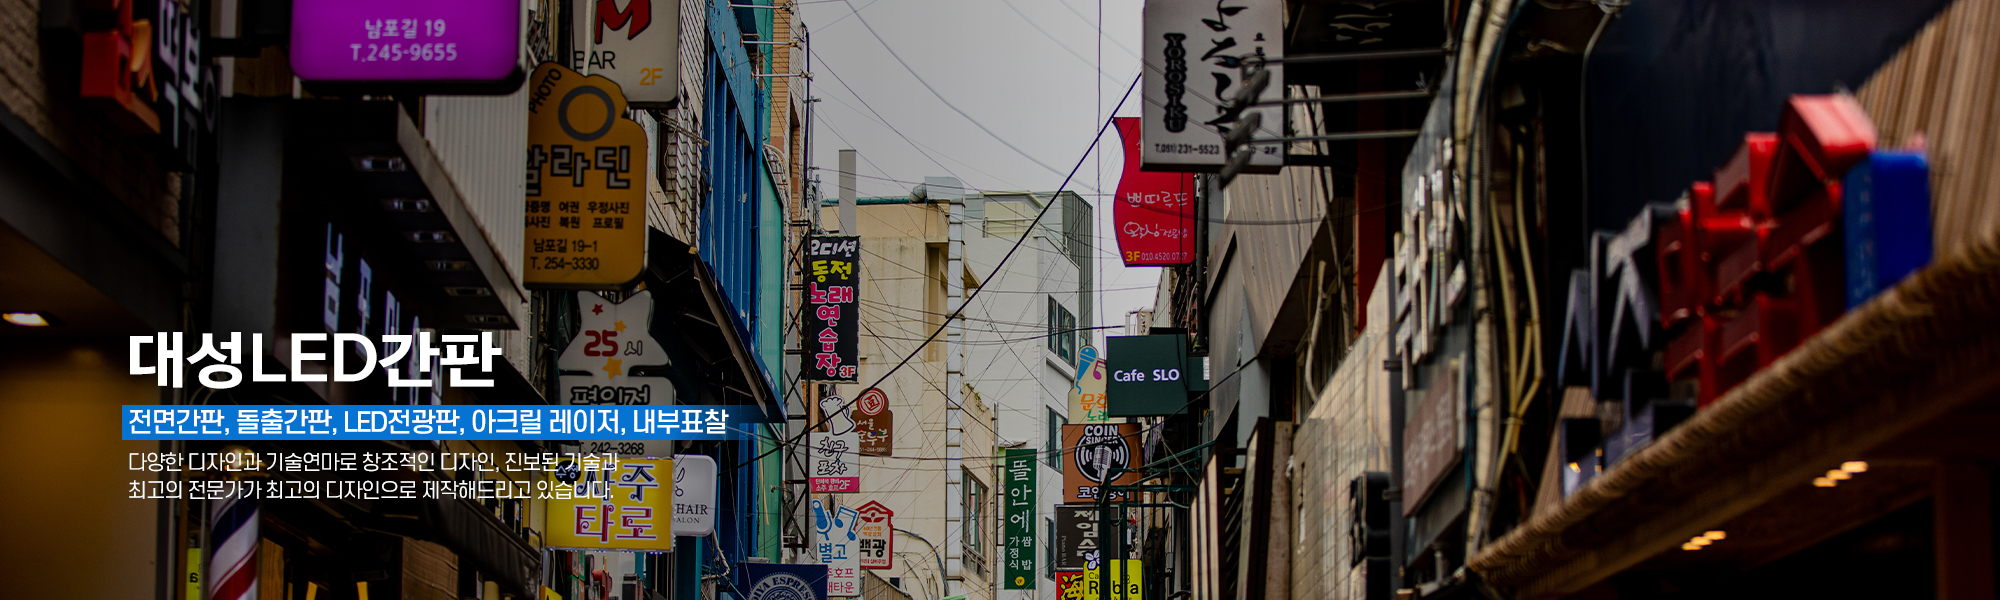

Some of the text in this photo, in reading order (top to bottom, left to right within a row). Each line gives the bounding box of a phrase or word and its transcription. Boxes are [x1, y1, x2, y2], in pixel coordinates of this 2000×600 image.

[365, 18, 447, 39] 남포길 19
[350, 42, 458, 62] T.245-9655
[573, 51, 616, 71] BAR
[640, 67, 663, 85] 2F
[1164, 33, 1187, 132] YOROSIKU
[529, 68, 562, 114] PHOTO
[559, 201, 580, 213] 여권
[587, 202, 630, 214] 우정사진
[593, 217, 624, 229] 프로필
[534, 239, 598, 253] 남포길 19-1
[807, 239, 857, 257] 오디션
[544, 257, 600, 270] 254-3330
[1125, 251, 1140, 262] 3F
[812, 259, 853, 283] 동전
[809, 282, 853, 304] 노래
[584, 330, 643, 356] 25 시
[839, 366, 856, 377] 3F
[1113, 368, 1180, 382] Cafe SLO
[857, 418, 875, 430] 서울
[1084, 425, 1119, 436] COIN
[590, 442, 644, 455] 242-3268
[818, 436, 849, 461] 친구
[817, 460, 847, 476] 포차
[575, 463, 659, 501] 사주
[839, 480, 851, 490] 2F
[1009, 460, 1032, 533] 뜰안에
[676, 503, 708, 515] HAIR
[573, 503, 657, 543] 타로
[819, 542, 847, 563] 별고
[828, 581, 854, 593] 타운
